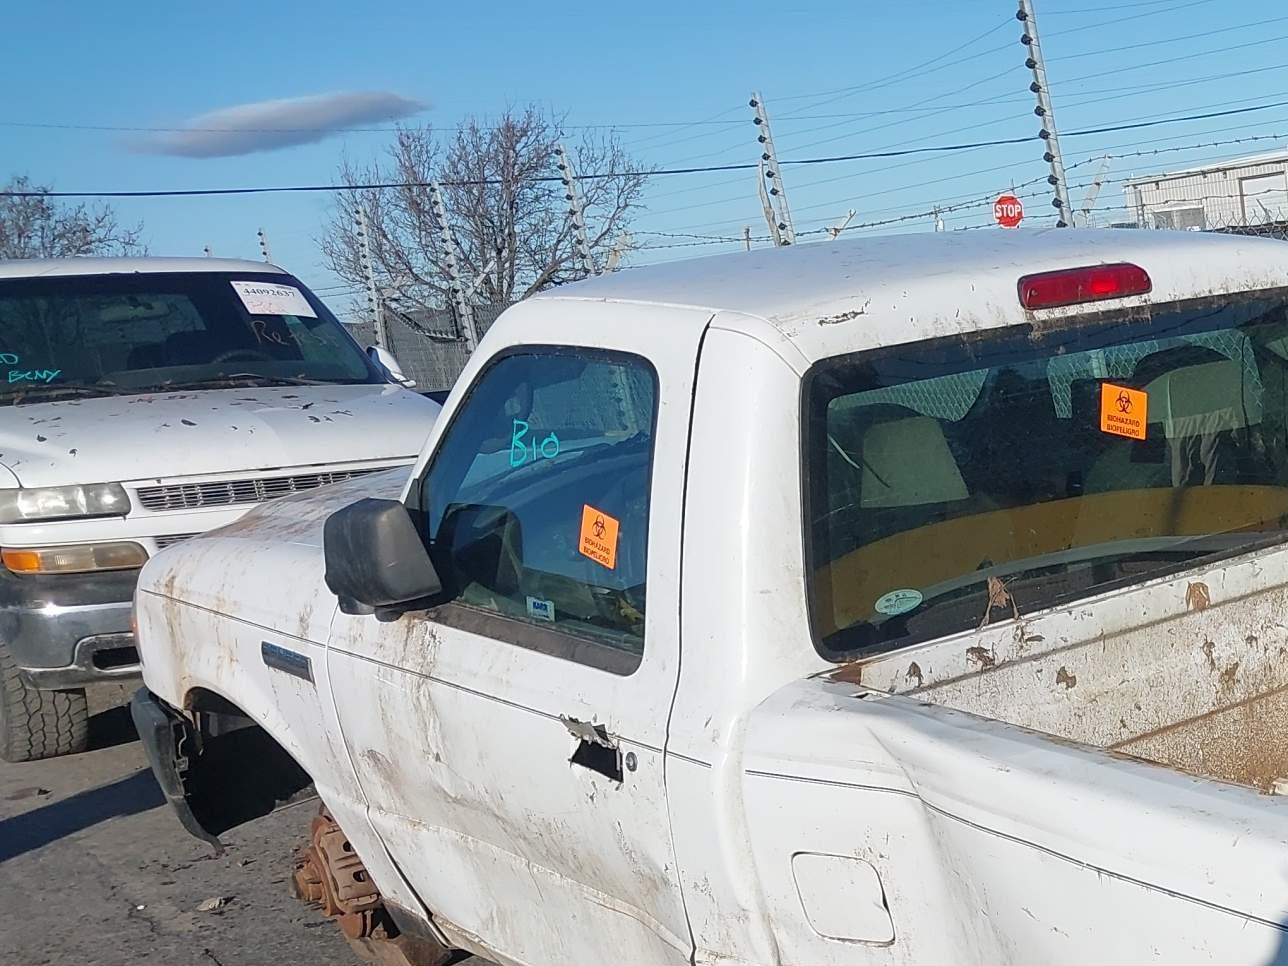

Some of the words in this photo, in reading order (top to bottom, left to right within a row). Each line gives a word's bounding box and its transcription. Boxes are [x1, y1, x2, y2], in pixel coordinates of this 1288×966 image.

[995, 204, 1021, 218] STOP
[1106, 414, 1141, 428] BIOHAZARD
[584, 536, 611, 555] BIOHAZARD
